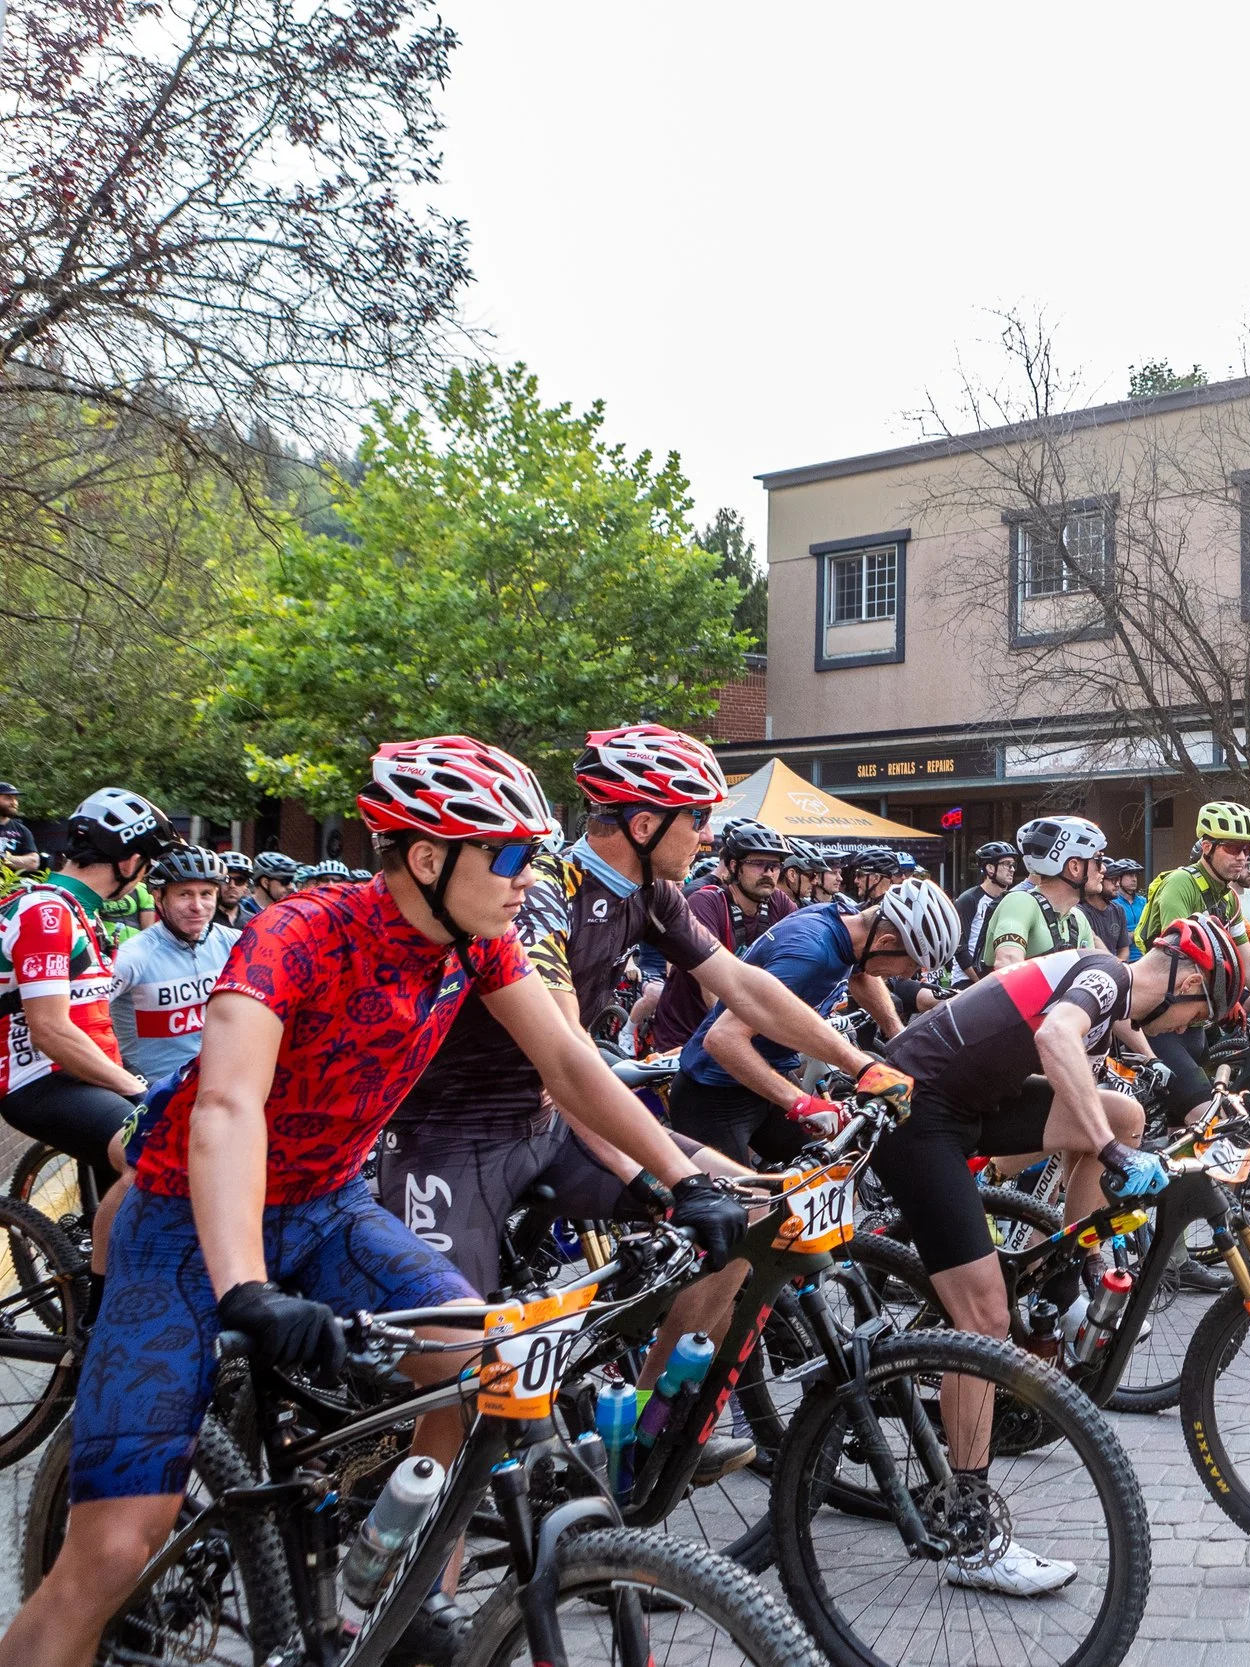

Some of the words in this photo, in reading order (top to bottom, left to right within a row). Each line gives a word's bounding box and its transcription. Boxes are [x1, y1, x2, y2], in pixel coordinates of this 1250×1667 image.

[636, 752, 655, 761] KALI
[407, 766, 426, 776] KALI
[857, 765, 877, 778] SALES
[887, 762, 916, 776] RENTALS
[927, 759, 955, 773] REPAIRS
[785, 816, 873, 827] SKOOKUM
[405, 1172, 454, 1252] Sal
[804, 1186, 847, 1236] 120
[1193, 1420, 1231, 1494] MAXXIS
